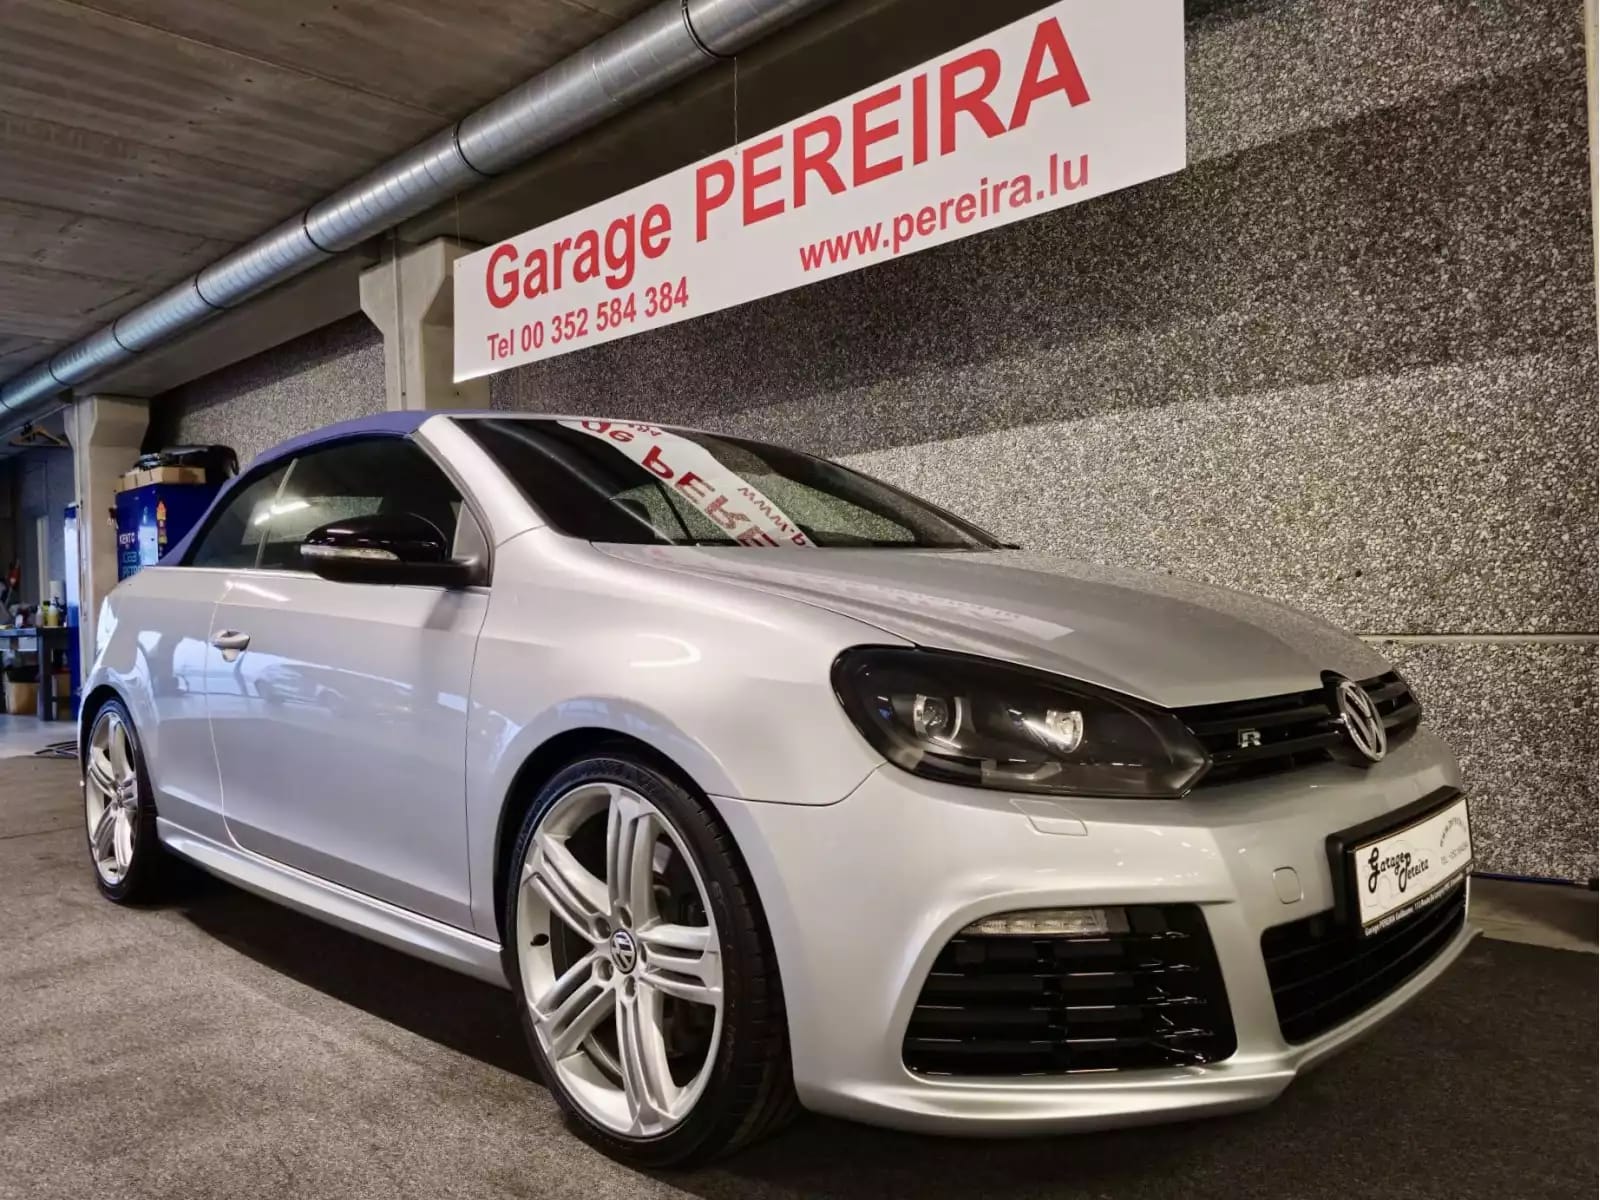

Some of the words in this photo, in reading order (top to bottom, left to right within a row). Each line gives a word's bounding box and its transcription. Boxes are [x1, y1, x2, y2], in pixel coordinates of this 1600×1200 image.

[485, 203, 672, 309] Garage
[695, 16, 1092, 243] PEREIRA
[799, 153, 1090, 272] www.pereira.lu
[487, 328, 516, 361] Tel
[520, 320, 545, 353] 00
[551, 307, 590, 345] 352
[596, 292, 637, 333] 584
[644, 276, 690, 319] 384
[1238, 728, 1262, 748] R
[1368, 847, 1406, 893] Garage
